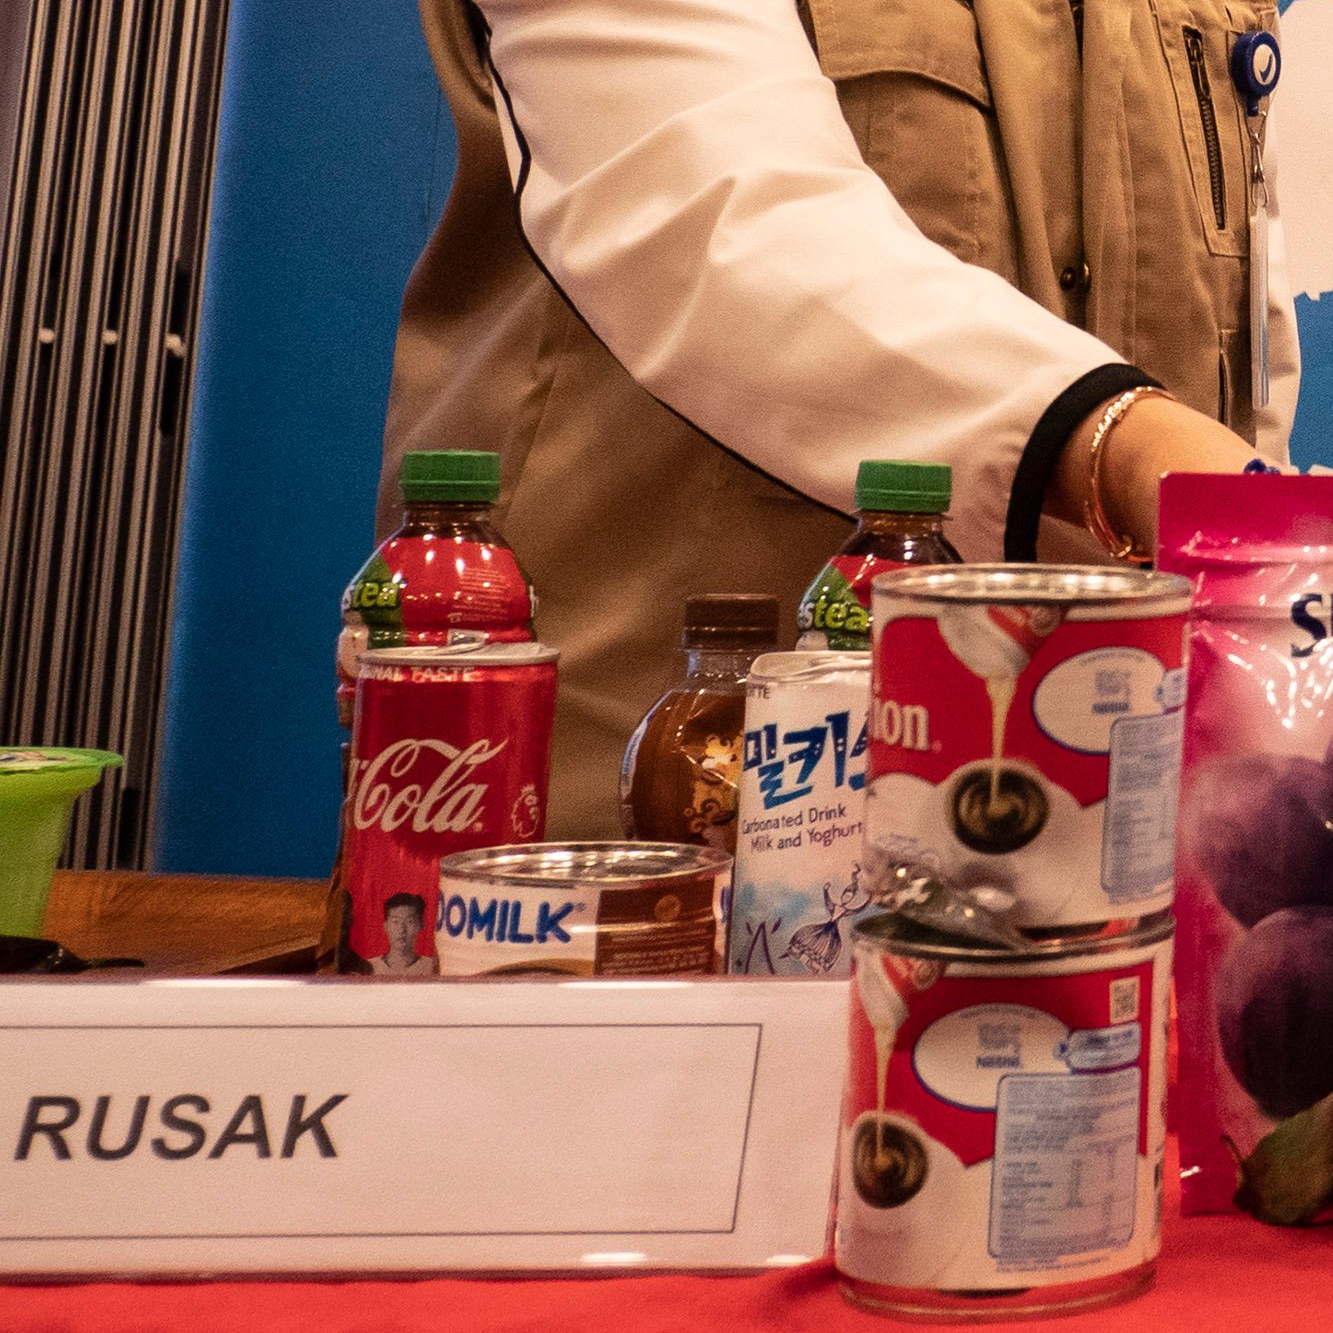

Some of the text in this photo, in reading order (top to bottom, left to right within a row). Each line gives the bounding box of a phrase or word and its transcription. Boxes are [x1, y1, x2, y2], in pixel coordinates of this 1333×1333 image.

[742, 803, 848, 835] Carbonated Drink
[751, 821, 864, 852] Milk and Yoghurt
[14, 1093, 349, 1162] RUSAK
